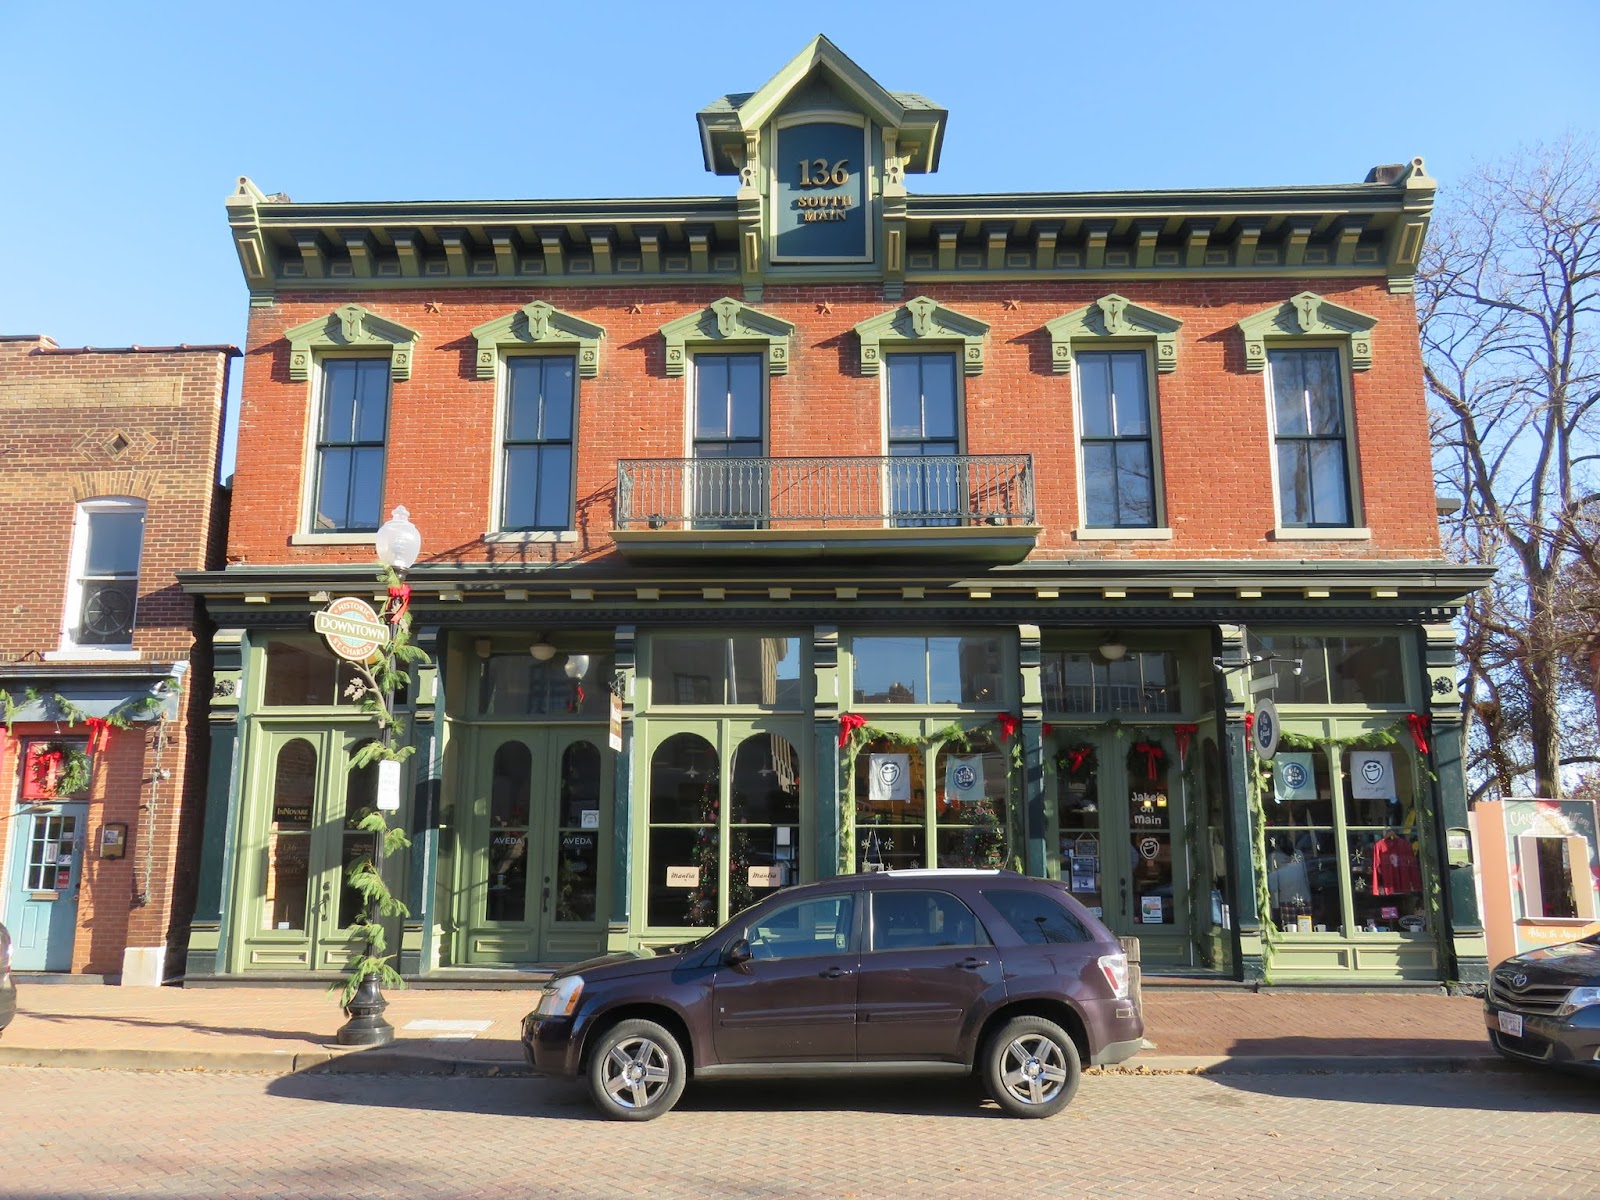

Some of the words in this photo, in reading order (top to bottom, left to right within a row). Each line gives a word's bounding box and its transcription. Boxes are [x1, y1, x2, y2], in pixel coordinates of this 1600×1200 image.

[799, 158, 849, 187] 136
[798, 194, 852, 208] SOUTH
[803, 208, 847, 223] MAIN
[338, 602, 372, 619] HISTORIC
[320, 615, 385, 641] DOWNTOWN
[341, 644, 373, 656] CHARLES
[1131, 791, 1166, 802] Jake's
[1140, 805, 1154, 813] on
[493, 837, 523, 845] AVEDA
[563, 837, 593, 845] AVEDA
